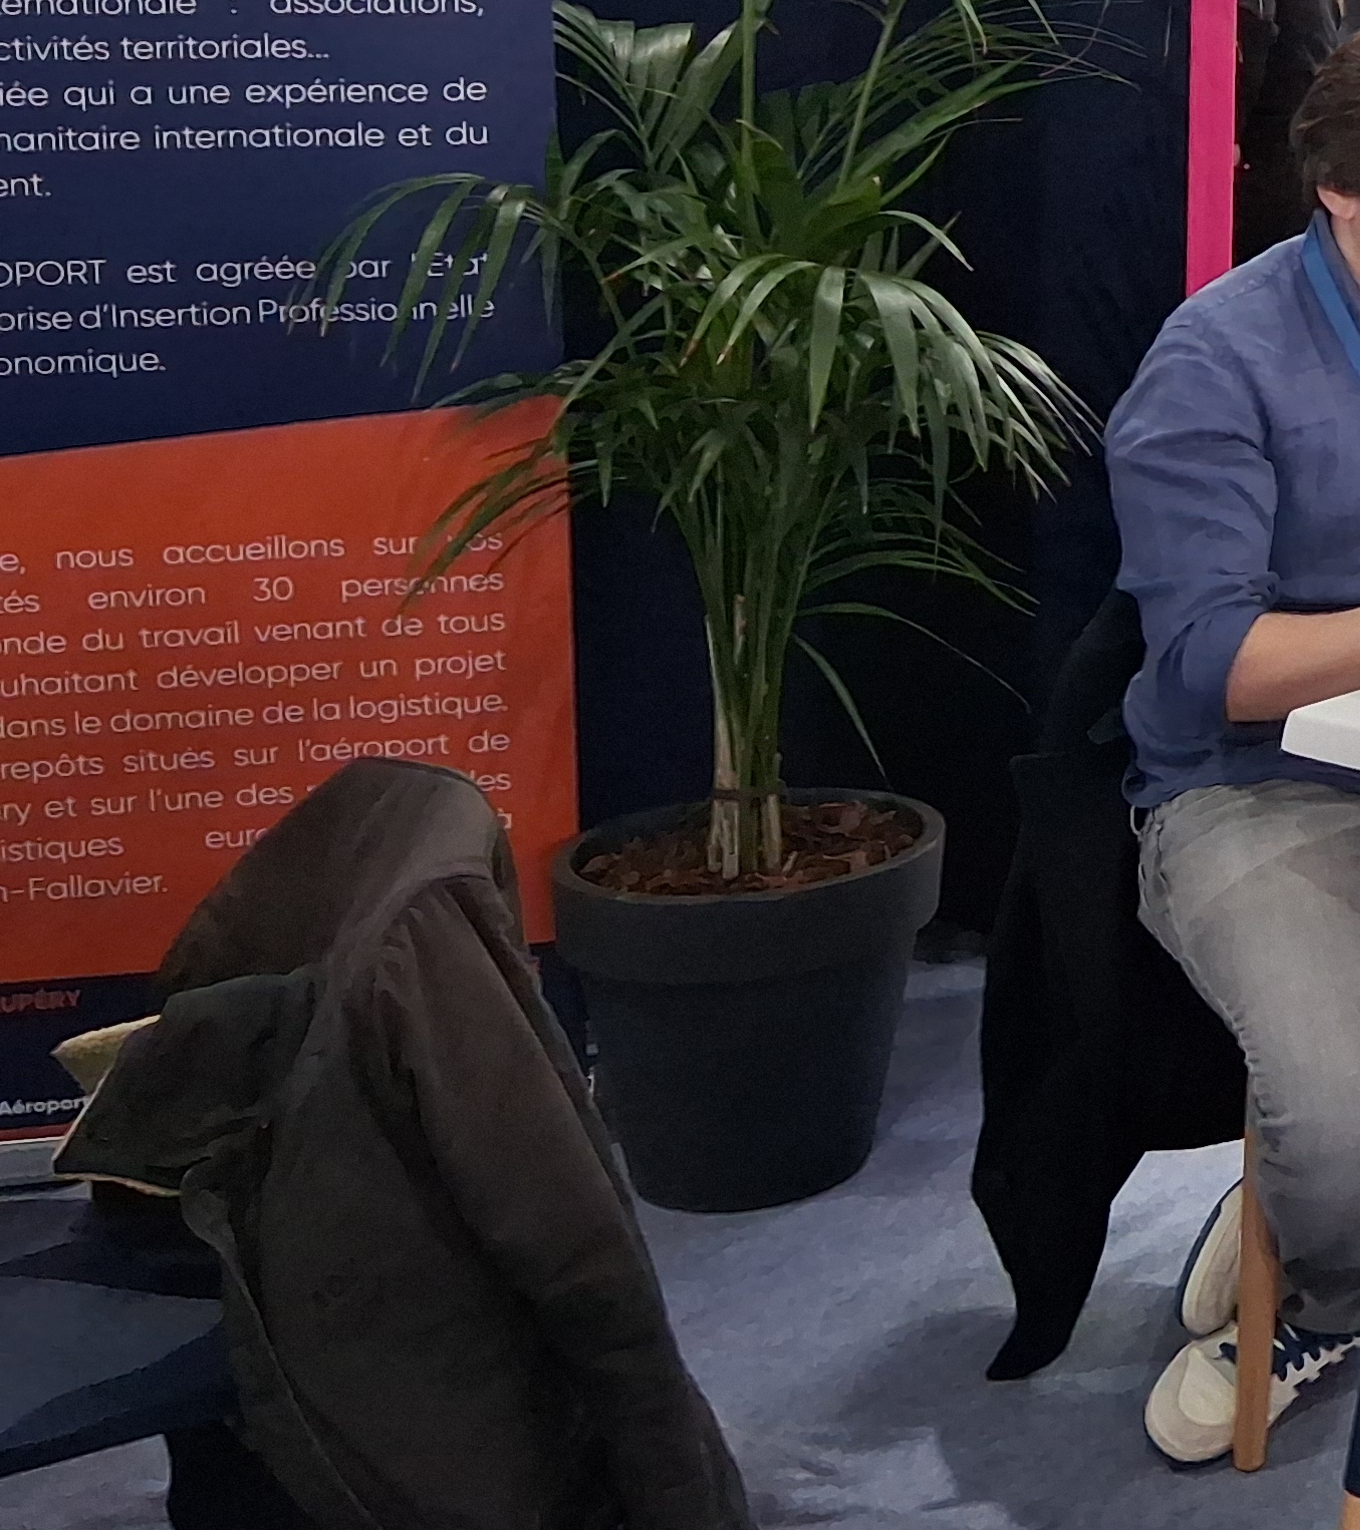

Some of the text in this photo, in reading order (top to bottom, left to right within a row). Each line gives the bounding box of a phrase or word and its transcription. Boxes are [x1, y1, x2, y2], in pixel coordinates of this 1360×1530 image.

[120, 33, 330, 60] territoriales...
[63, 77, 488, 113] qui a une expérience de
[154, 121, 489, 150] internationale et du
[126, 254, 317, 289] est agréée
[79, 301, 251, 331] d'Insertion
[55, 534, 417, 569] nous accueillons sur
[88, 571, 505, 611] environ 30 personnes
[82, 610, 506, 651] du travail venant de tous
[157, 649, 507, 695] développer un projet
[110, 689, 510, 733] domaine logistique.
[123, 745, 215, 773] situés
